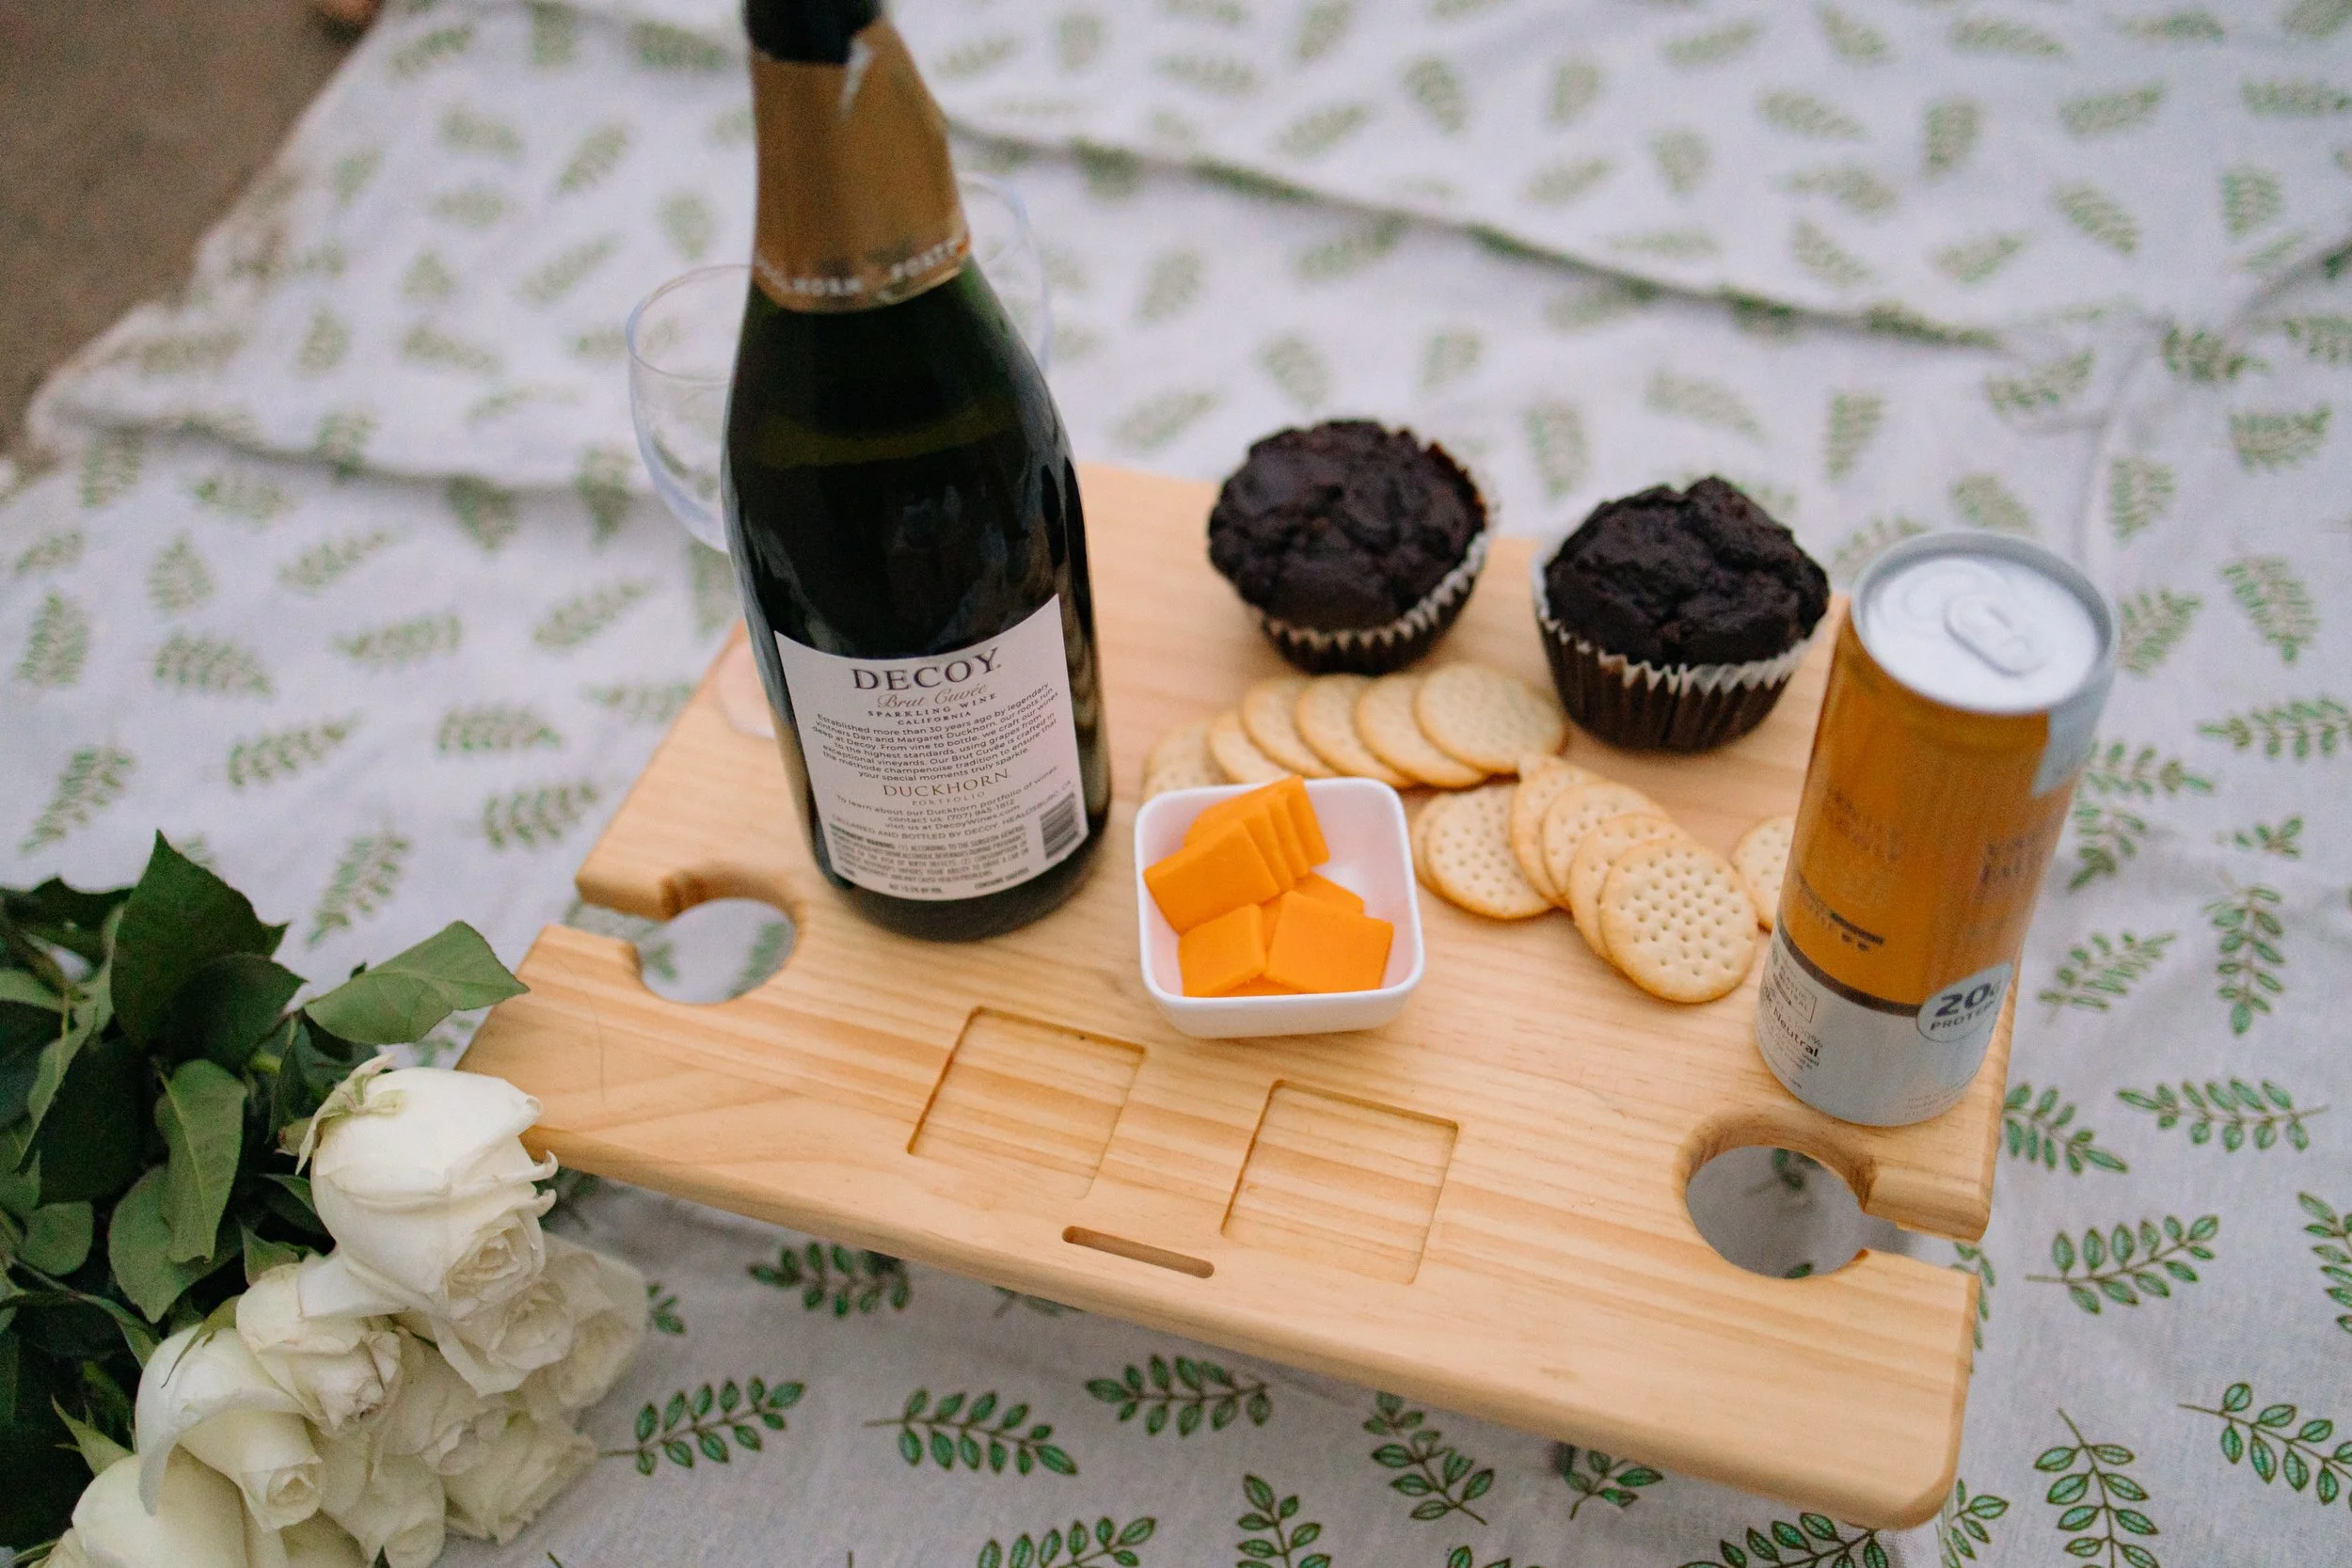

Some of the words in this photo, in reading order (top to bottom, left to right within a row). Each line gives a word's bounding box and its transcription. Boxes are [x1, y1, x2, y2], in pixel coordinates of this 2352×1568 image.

[817, 713, 870, 734] Established
[945, 721, 972, 733] years
[974, 715, 992, 724] ago
[994, 708, 1006, 717] by
[1008, 681, 1049, 711] legendary
[867, 706, 951, 717] SPARKLING
[960, 693, 996, 708] WINE
[876, 693, 925, 708] Brut
[934, 683, 988, 705] Cuvée
[812, 726, 834, 739] deep
[982, 729, 996, 737] we
[998, 719, 1020, 732] craft
[1022, 709, 1036, 721] our
[1037, 691, 1058, 711] wines
[815, 721, 850, 737] vintners
[852, 733, 873, 741] Dan
[897, 734, 944, 744] Margaret
[1000, 713, 1015, 723] our
[1017, 698, 1039, 715] roots
[1040, 688, 1053, 700] run
[898, 711, 971, 725] CALIFORNIA
[822, 744, 875, 765] exceptional
[951, 752, 973, 762] Brut
[1016, 719, 1046, 740] crafted
[822, 751, 836, 761] the
[884, 765, 953, 774] champenoise
[956, 753, 998, 768] tradition
[1011, 732, 1041, 751] ensure
[1041, 719, 1057, 733] that
[846, 746, 862, 754] the
[864, 750, 901, 758] highest
[960, 741, 987, 752] using
[989, 728, 1020, 745] grapes
[1022, 714, 1042, 729] from
[882, 768, 1009, 798] DUCKHORN
[919, 769, 969, 781] moments
[971, 763, 994, 774] truly
[912, 791, 985, 806] PORTFOLIO
[926, 804, 977, 816] Duckhorn
